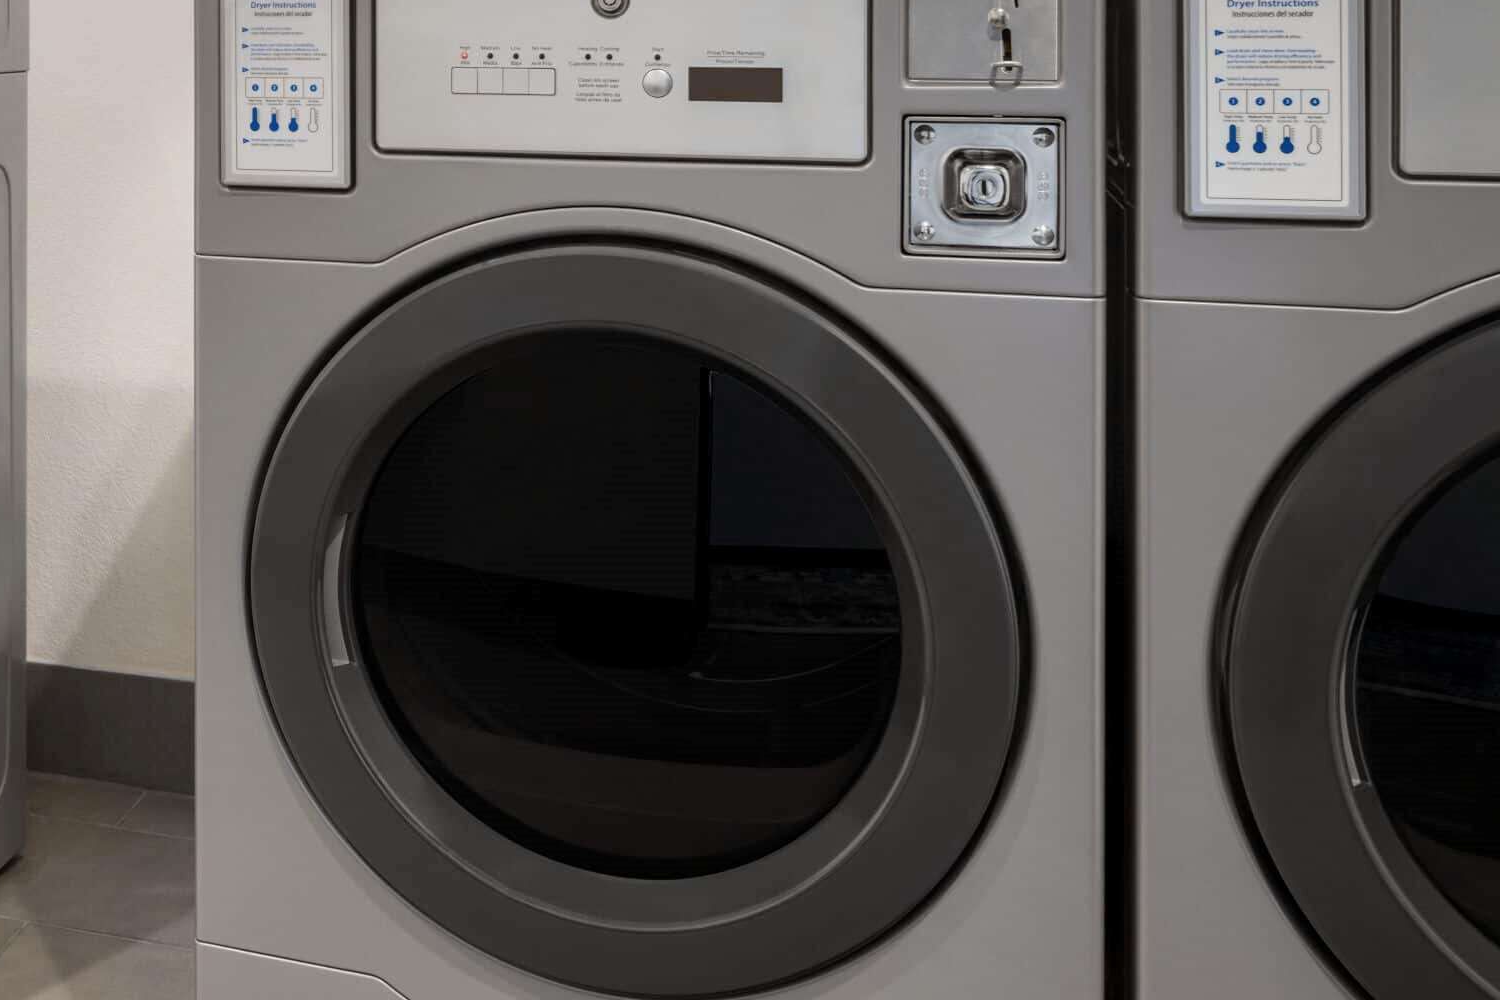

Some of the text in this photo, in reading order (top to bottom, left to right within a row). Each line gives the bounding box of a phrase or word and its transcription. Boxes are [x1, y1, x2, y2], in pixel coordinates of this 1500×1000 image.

[250, 1, 271, 10] Dryer
[1226, 0, 1320, 9] Dryer Instructions
[1232, 10, 1275, 18] Instrucciones
[1276, 10, 1287, 18] del
